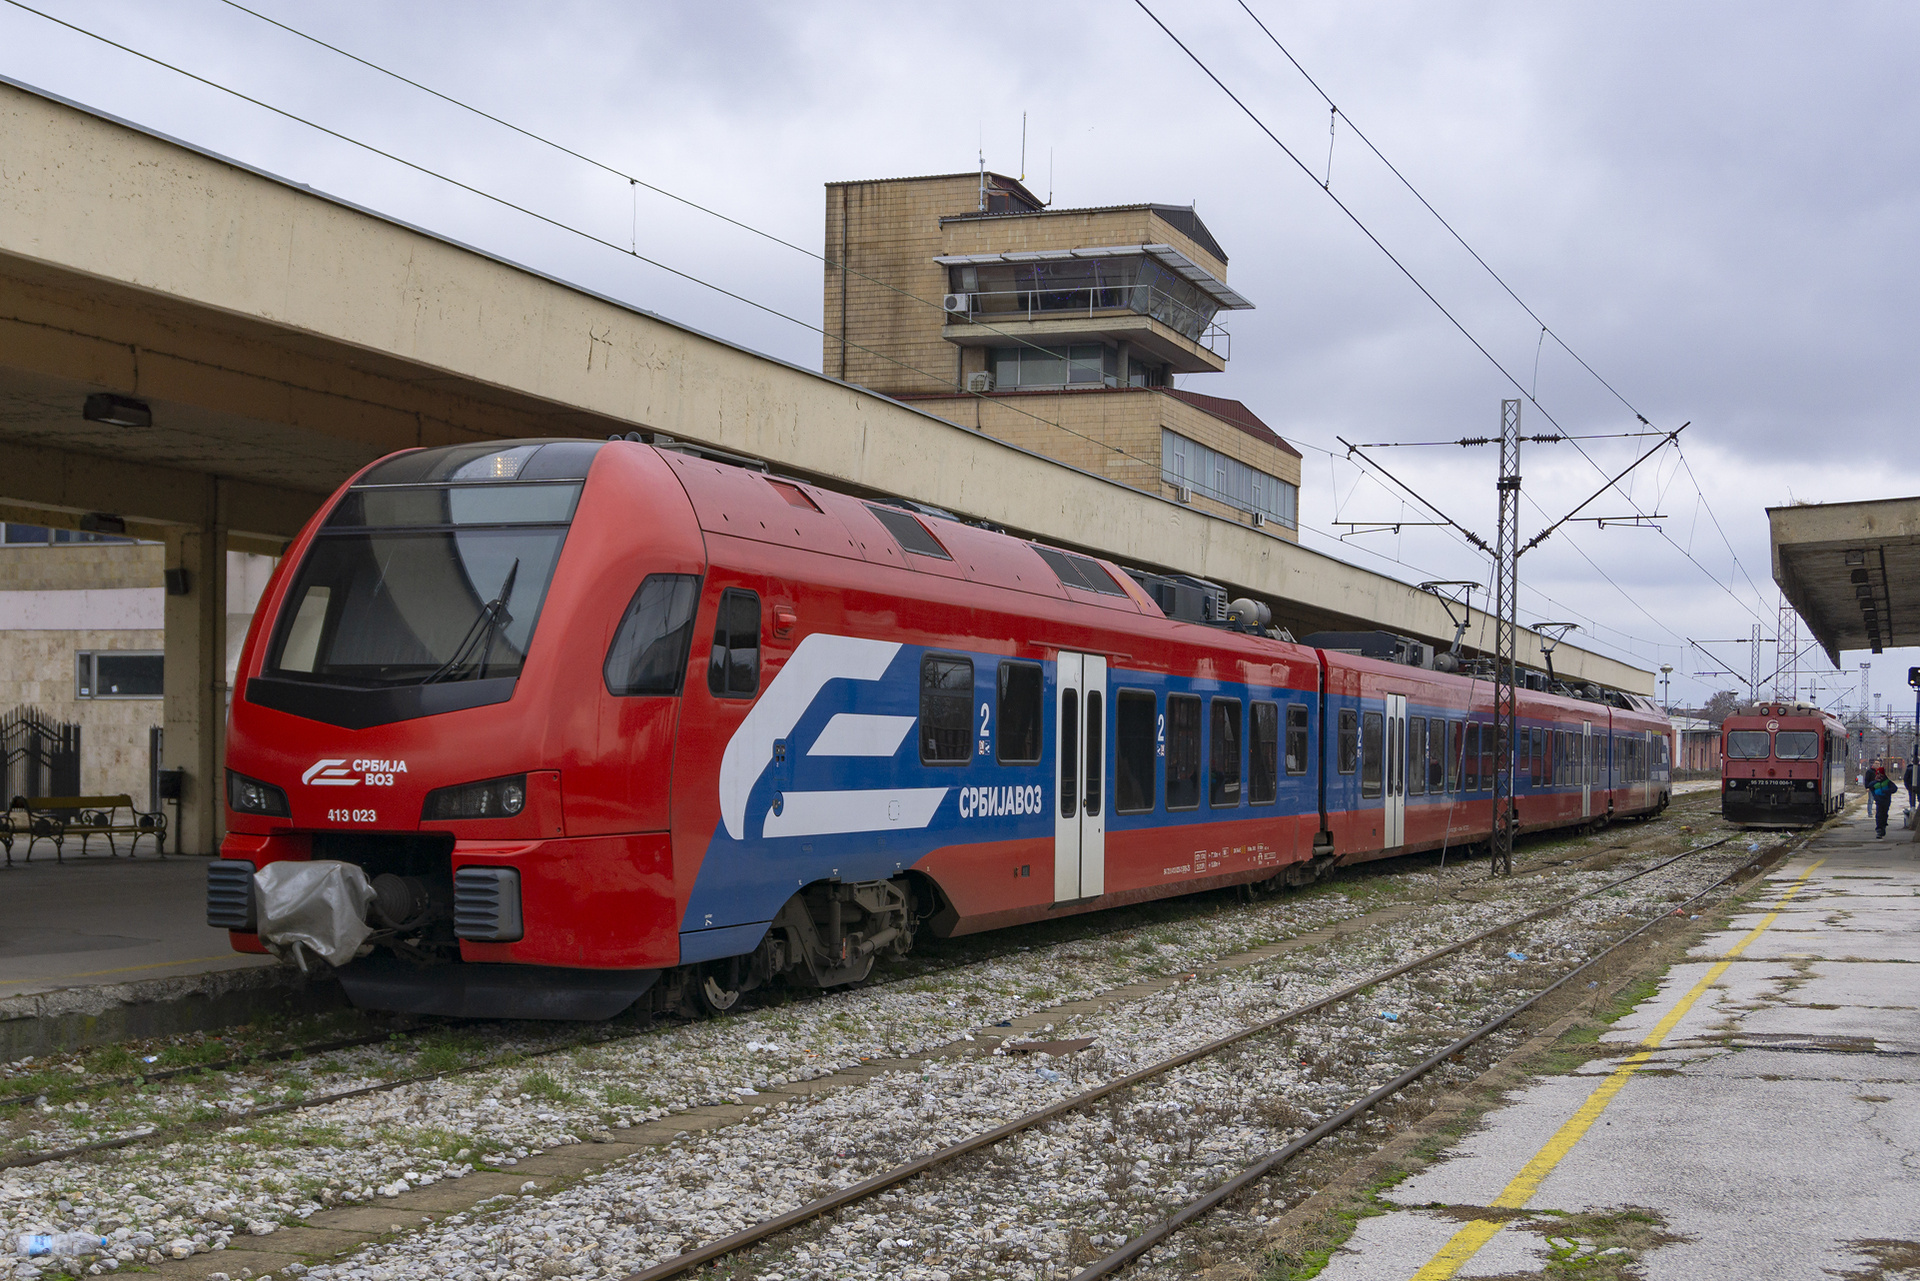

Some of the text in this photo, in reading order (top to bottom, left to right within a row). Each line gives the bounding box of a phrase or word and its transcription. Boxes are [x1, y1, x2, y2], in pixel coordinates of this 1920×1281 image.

[980, 702, 990, 737] 2
[1157, 713, 1164, 742] 2
[1357, 726, 1362, 747] 2
[352, 759, 408, 773] СРБИЈА
[365, 773, 394, 786] ВОЗ
[959, 784, 1042, 818] СРБИЈАВОЗ
[327, 808, 377, 822] 413 023
